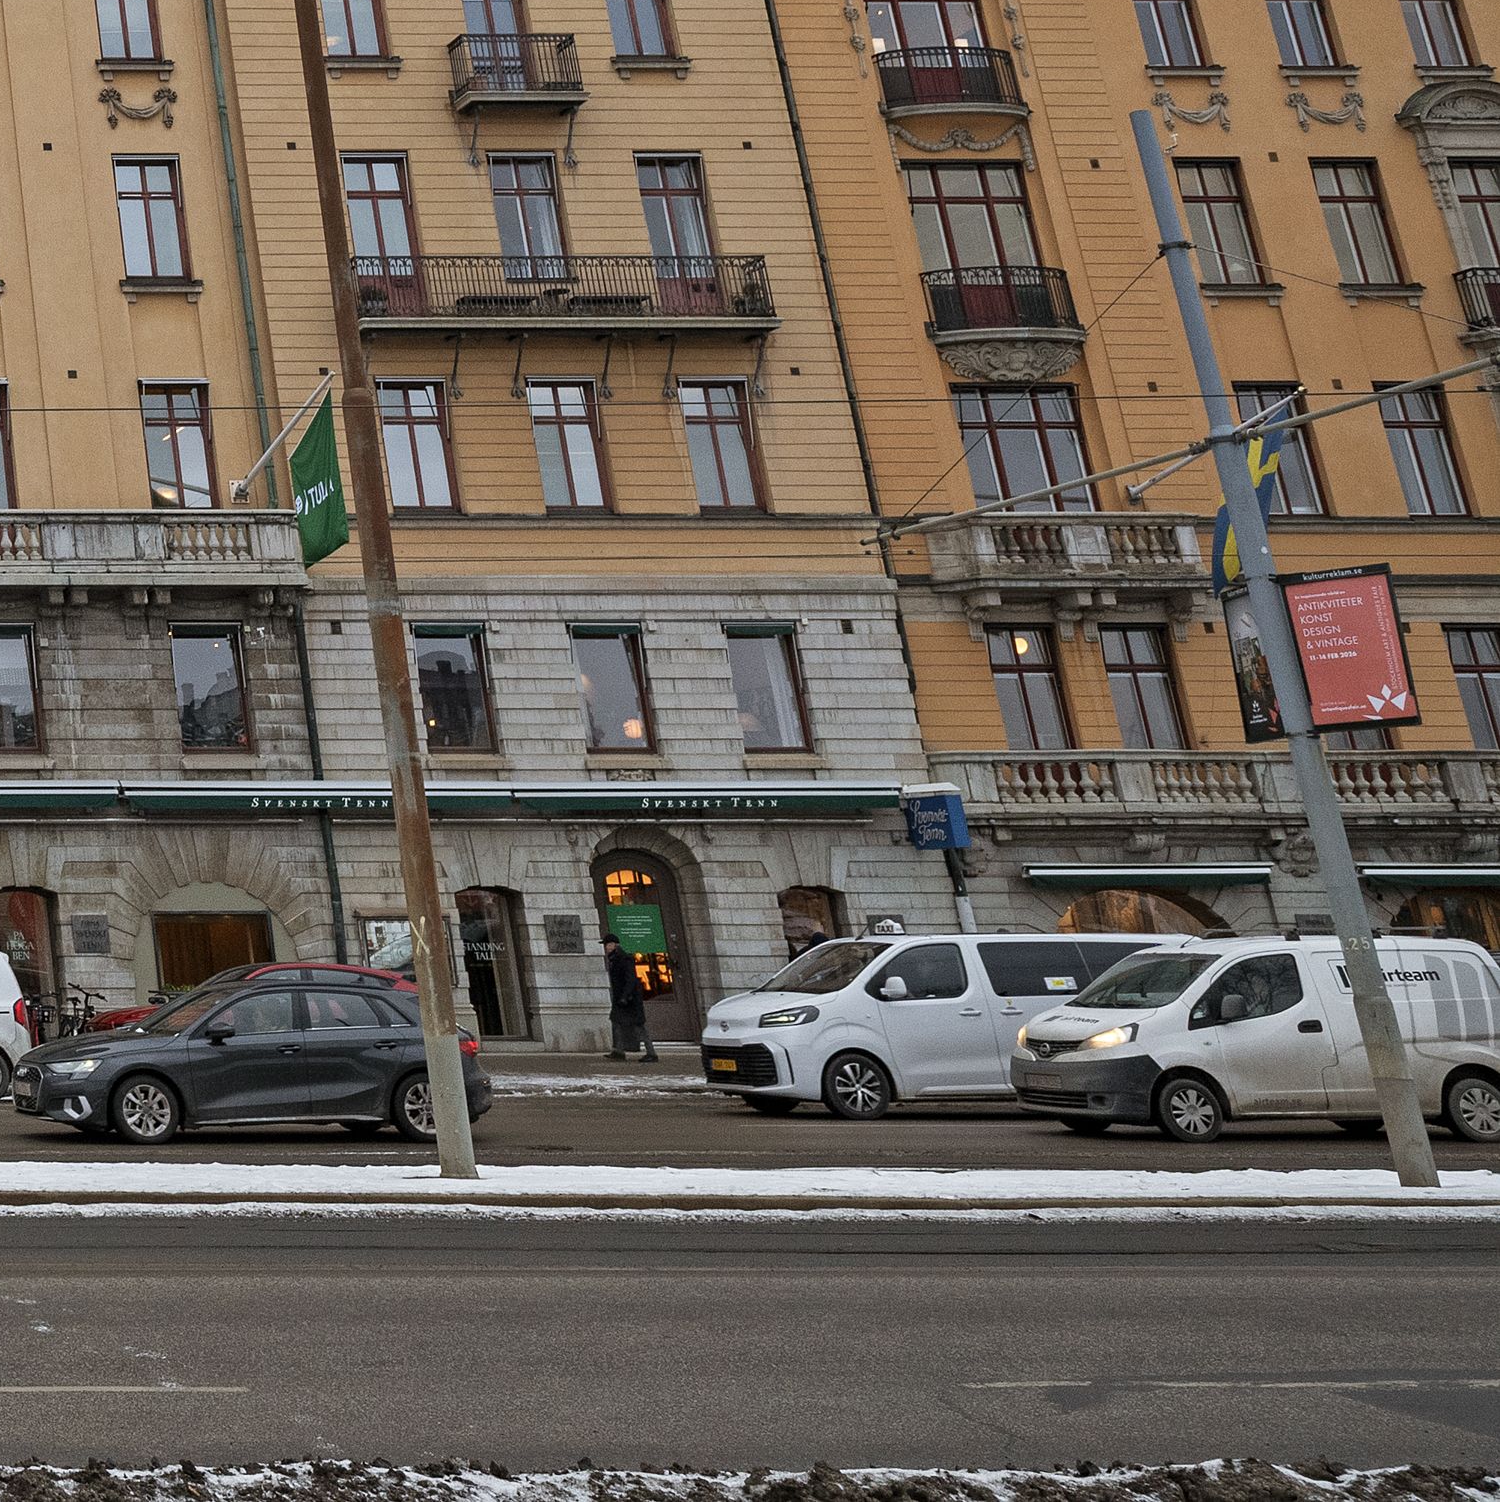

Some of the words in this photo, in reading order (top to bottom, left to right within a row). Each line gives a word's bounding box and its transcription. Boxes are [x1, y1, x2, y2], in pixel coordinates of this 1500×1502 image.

[1303, 567, 1363, 581] kulturreklam.se
[1297, 596, 1364, 613] ANTIKVITETER
[1299, 612, 1334, 625] KONST
[1303, 624, 1341, 638] DESIGN
[1306, 640, 1314, 650] &
[1316, 635, 1359, 649] VINTAGE
[251, 797, 332, 807] SVENSKT
[341, 797, 389, 807] TENN
[641, 797, 723, 808] SVENSKT
[730, 797, 778, 807] TENN
[877, 925, 894, 933] TAXI
[12, 951, 30, 961] BEN
[474, 951, 494, 961] TALL
[1381, 968, 1441, 982] irteam
